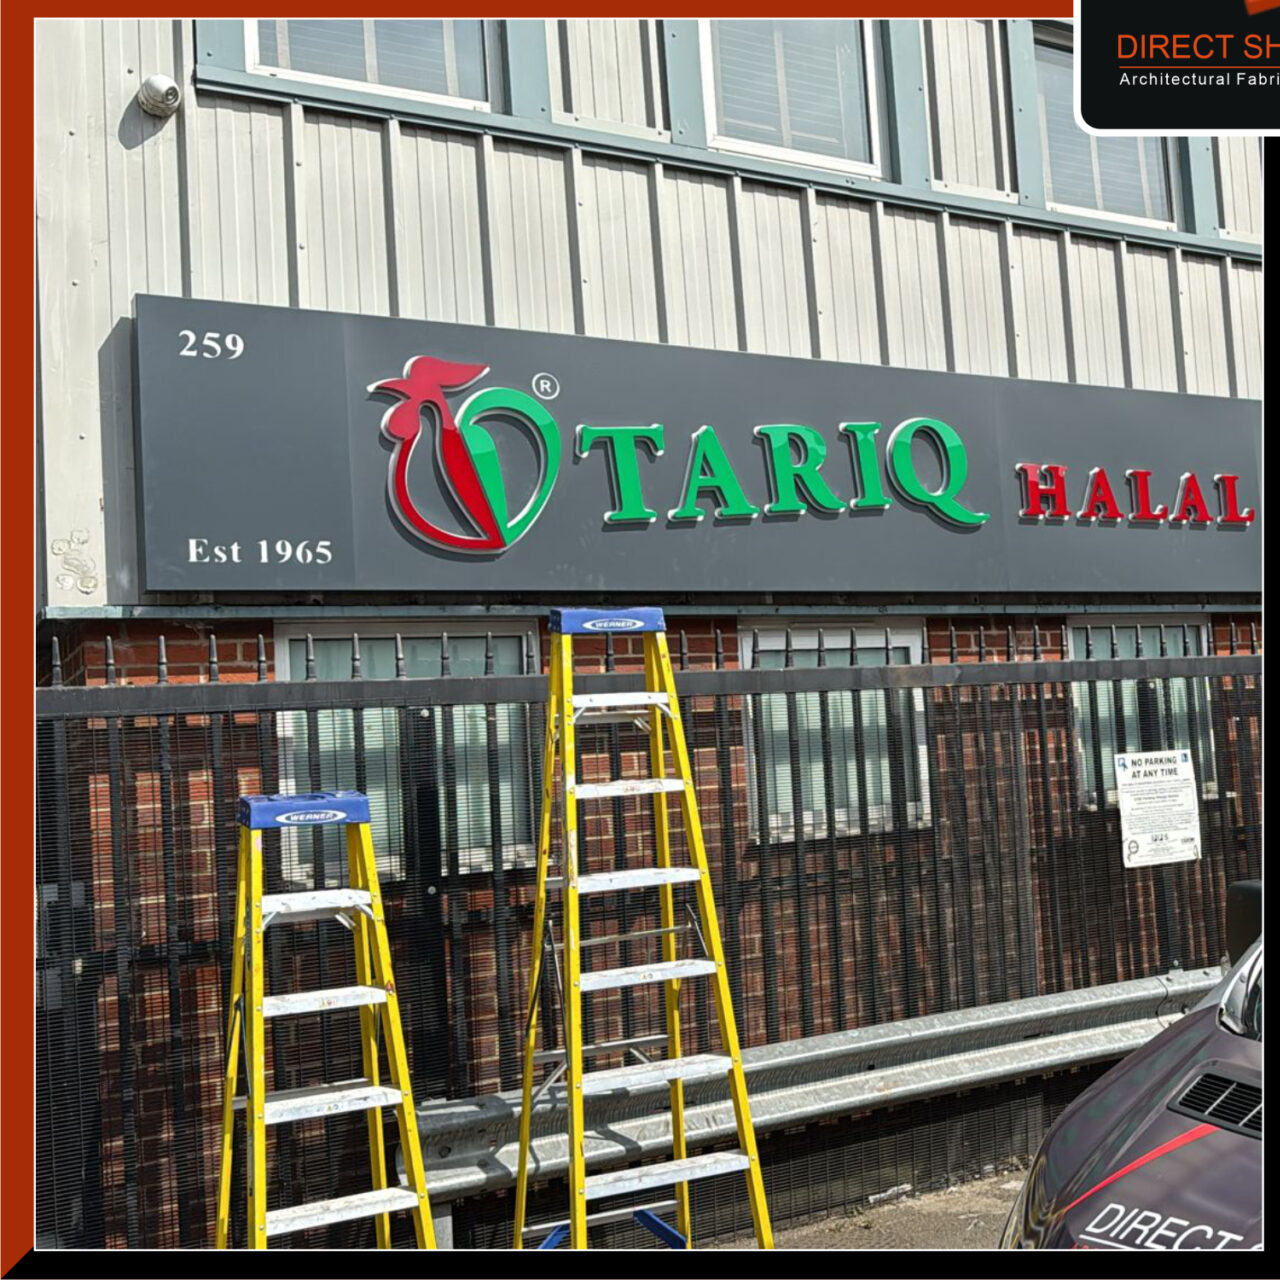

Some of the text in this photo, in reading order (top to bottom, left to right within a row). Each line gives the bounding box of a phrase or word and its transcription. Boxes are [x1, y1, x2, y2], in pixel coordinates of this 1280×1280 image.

[178, 329, 246, 361] 259
[575, 417, 1256, 527] TARIQ HALAL
[187, 537, 333, 566] Est 1965
[595, 620, 634, 628] WERNER
[1131, 756, 1177, 766] NO PARKING
[1131, 767, 1178, 778] AT ANY TIME
[289, 812, 334, 821] WERNER
[1085, 1203, 1244, 1250] DIRECT
